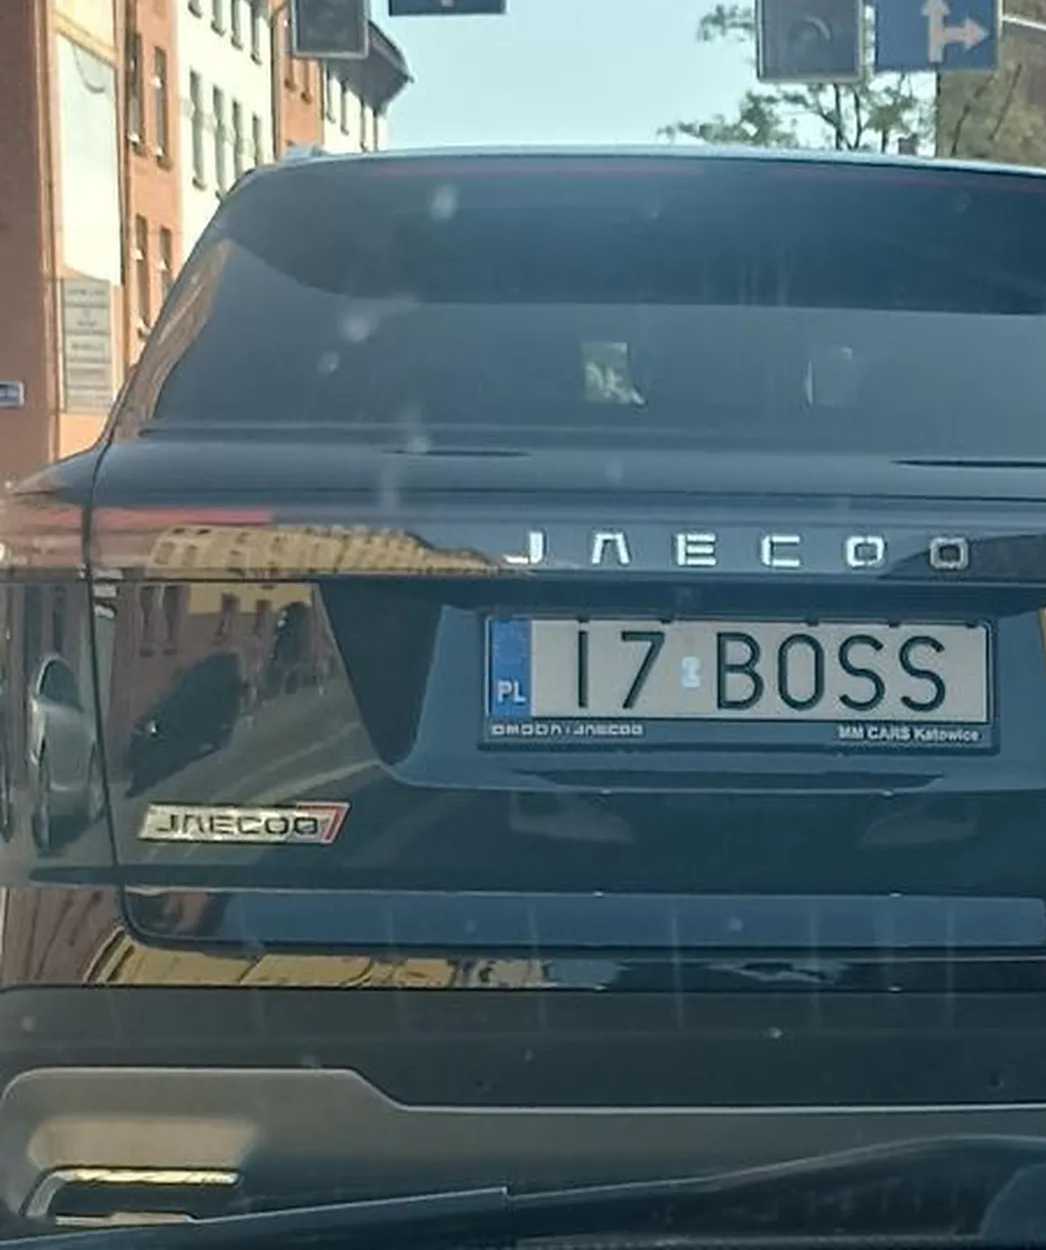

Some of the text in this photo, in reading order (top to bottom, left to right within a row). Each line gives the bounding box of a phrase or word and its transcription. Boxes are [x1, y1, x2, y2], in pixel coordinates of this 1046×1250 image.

[503, 531, 969, 571] JAECOO
[716, 631, 946, 712] BOSS
[498, 681, 526, 704] PL
[867, 726, 911, 741] CARS
[914, 727, 980, 743] Katowice
[156, 814, 319, 835] JAECOO
